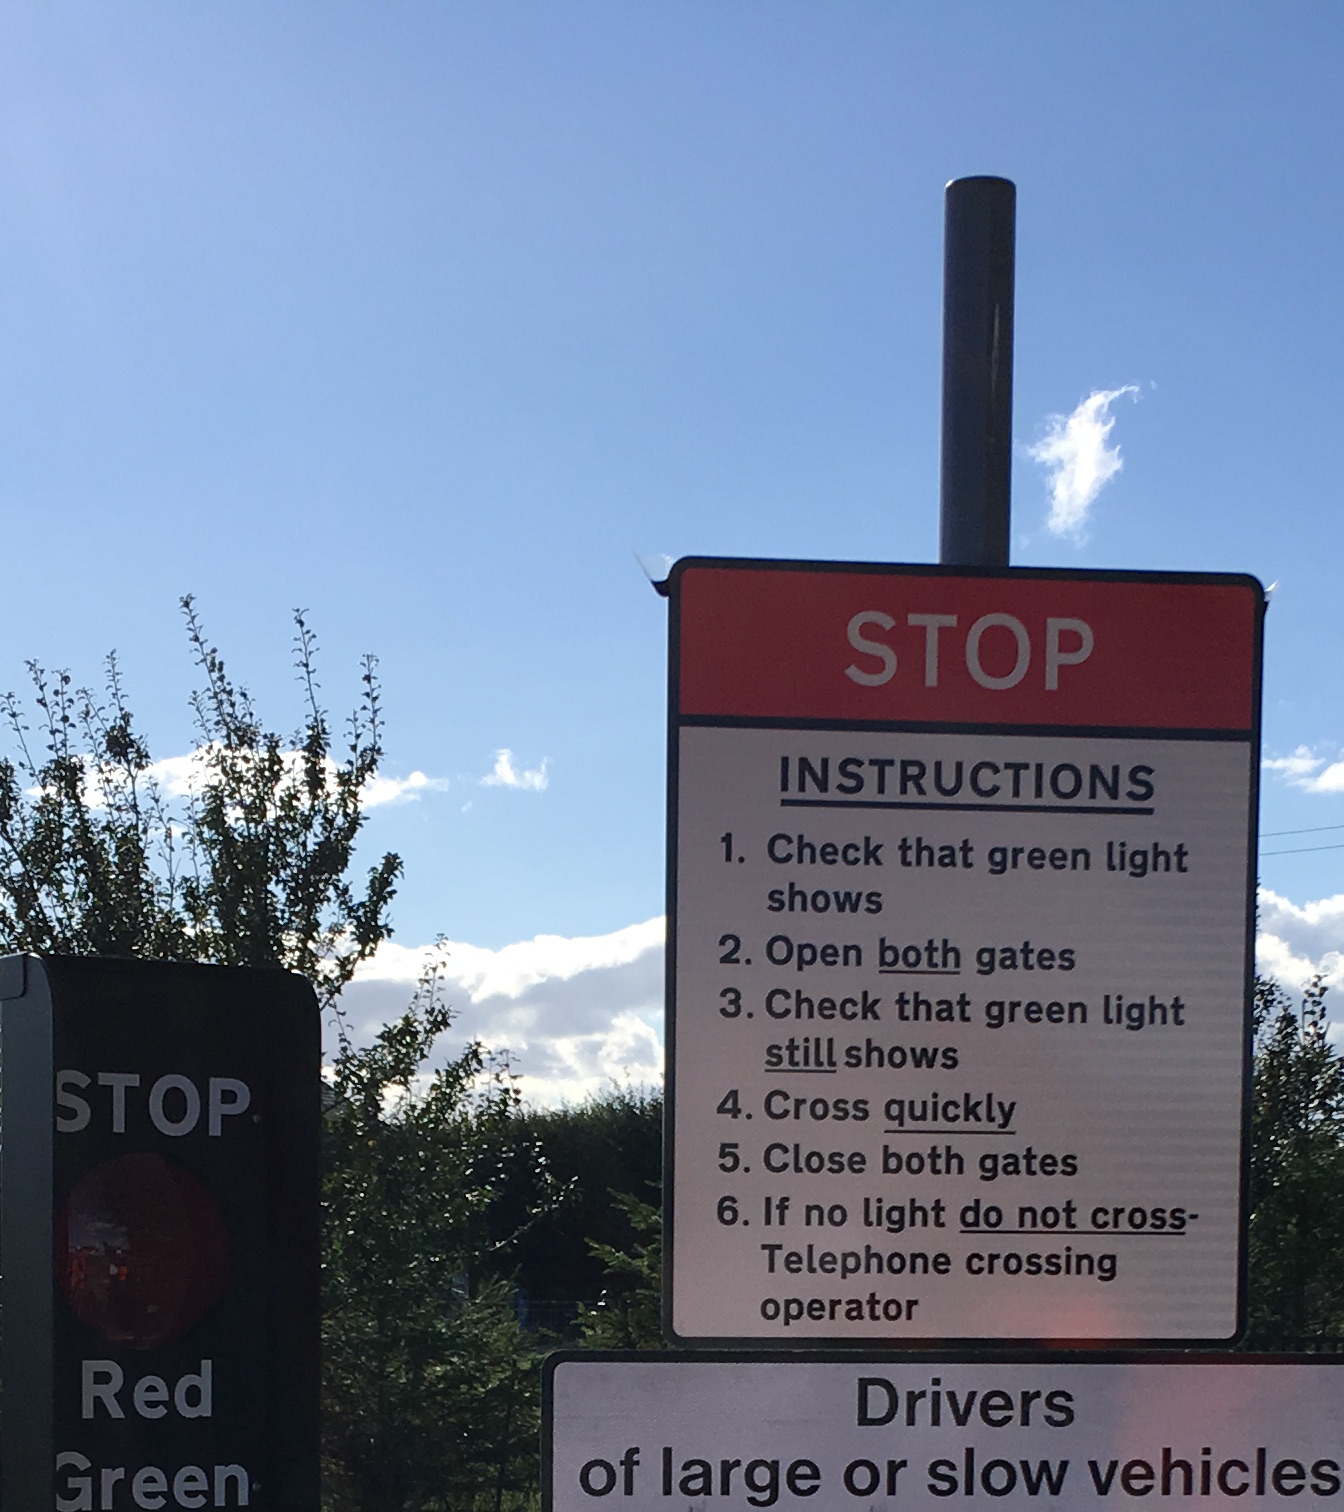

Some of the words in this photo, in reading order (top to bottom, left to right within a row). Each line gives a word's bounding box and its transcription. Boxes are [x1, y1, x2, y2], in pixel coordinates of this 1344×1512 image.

[844, 610, 1094, 691] STOP
[779, 756, 1156, 802] INSTRUCTIONS
[720, 832, 745, 864] 1.
[766, 833, 883, 867] Check
[898, 838, 974, 869] that
[988, 845, 1090, 876] green
[1106, 842, 1189, 878] light
[766, 883, 883, 914] shows
[719, 934, 752, 966] 2.
[765, 935, 862, 971] Open
[878, 938, 961, 970] both
[976, 942, 1076, 974] gates
[719, 988, 754, 1020] 3.
[764, 989, 881, 1021] Check
[895, 991, 971, 1023] that
[985, 998, 1088, 1029] green
[1102, 995, 1185, 1031] light
[764, 1038, 837, 1067] still
[844, 1039, 959, 1070] shows
[56, 1069, 252, 1137] STOP
[716, 1090, 753, 1121] 4.
[763, 1091, 870, 1122] Cross
[884, 1093, 1017, 1130] quickly
[719, 1143, 750, 1174] 5.
[763, 1144, 867, 1175] Close
[881, 1145, 964, 1176] both
[978, 1148, 1078, 1180] gates
[717, 1196, 749, 1228] 6.
[763, 1197, 790, 1227] If
[805, 1205, 848, 1228] no
[863, 1197, 945, 1234] light
[959, 1199, 1003, 1230] do
[1018, 1203, 1077, 1230] not
[761, 1244, 952, 1279] Telephone
[965, 1247, 1118, 1282] crossing
[760, 1293, 919, 1326] operator
[81, 1360, 213, 1420] Red
[856, 1376, 1076, 1428] Drivers
[579, 1447, 640, 1497] of
[662, 1446, 822, 1507] large
[843, 1458, 908, 1497] or
[926, 1446, 1067, 1497] slow
[1087, 1447, 1341, 1497] vehicles
